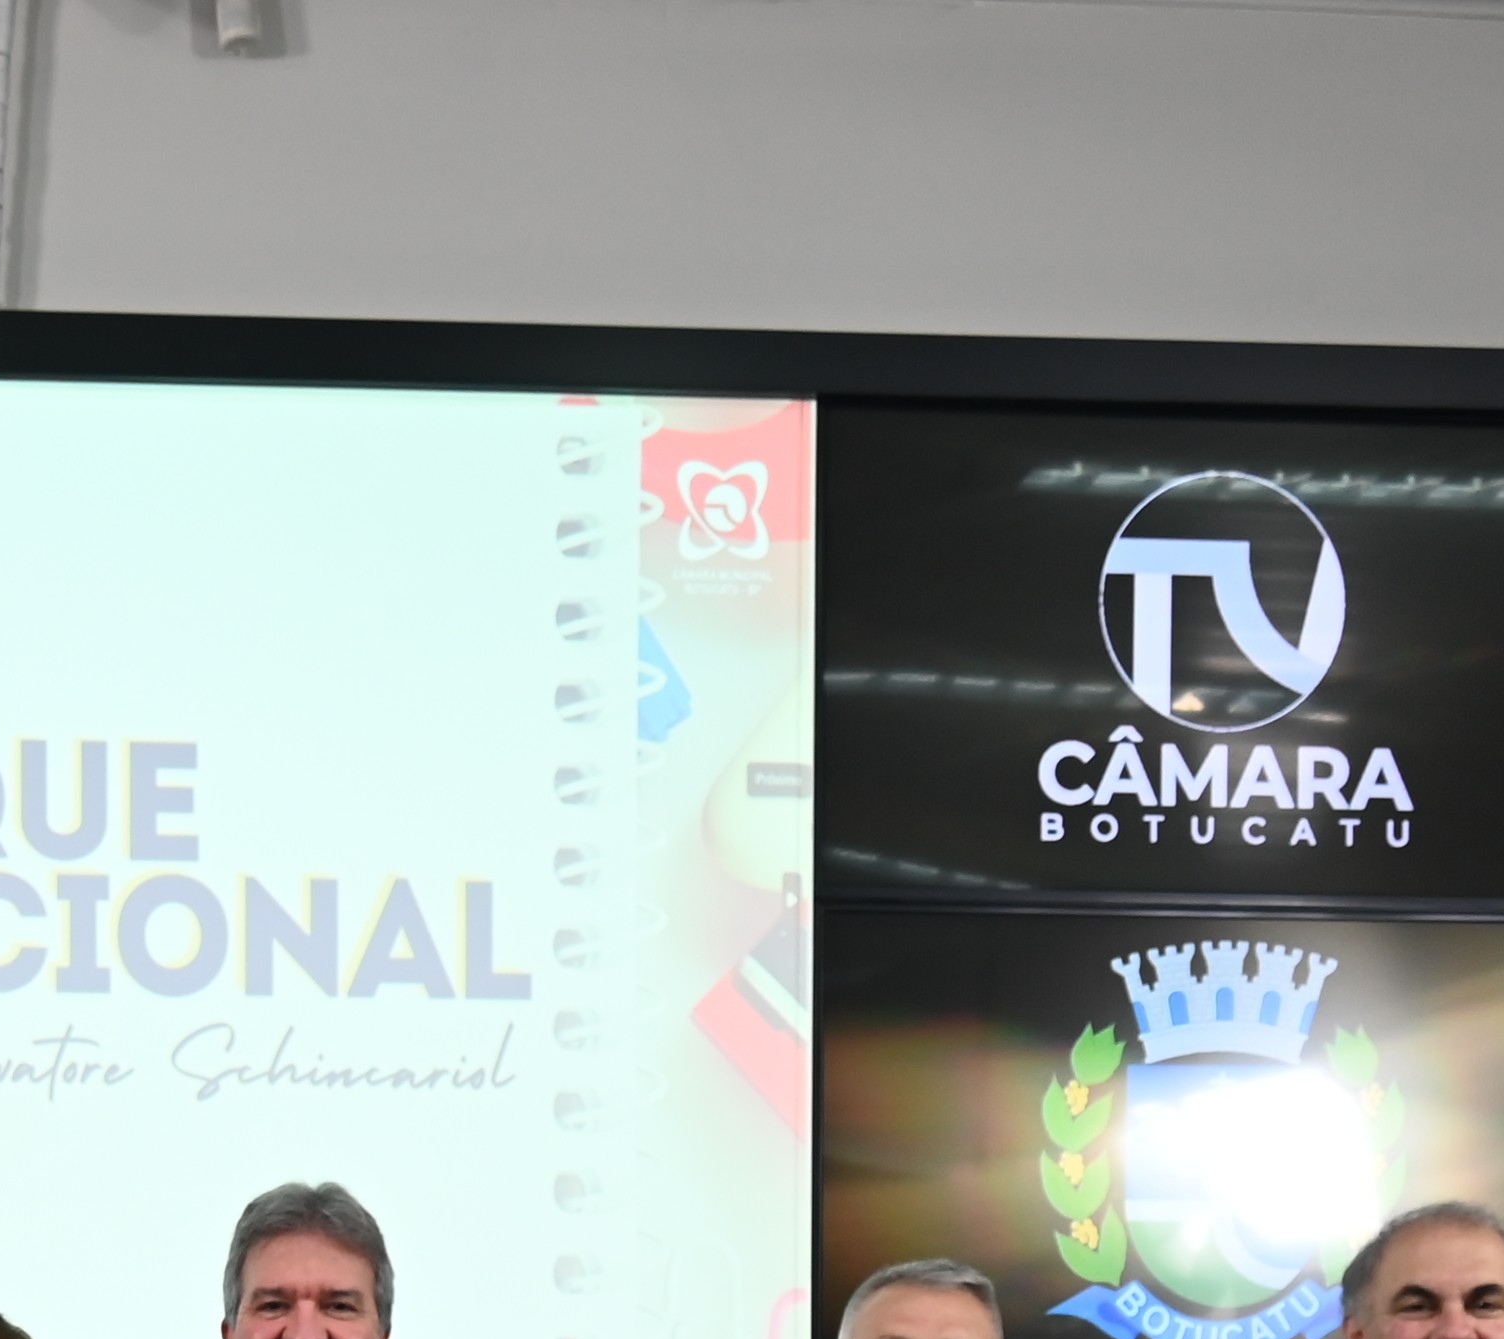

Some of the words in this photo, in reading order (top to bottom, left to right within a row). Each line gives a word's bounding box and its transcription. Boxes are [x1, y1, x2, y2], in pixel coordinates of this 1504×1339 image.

[1037, 725, 1414, 811] CÂMARA
[1040, 812, 1411, 848] BOTUCATU
[170, 1021, 518, 1102] Schincariol
